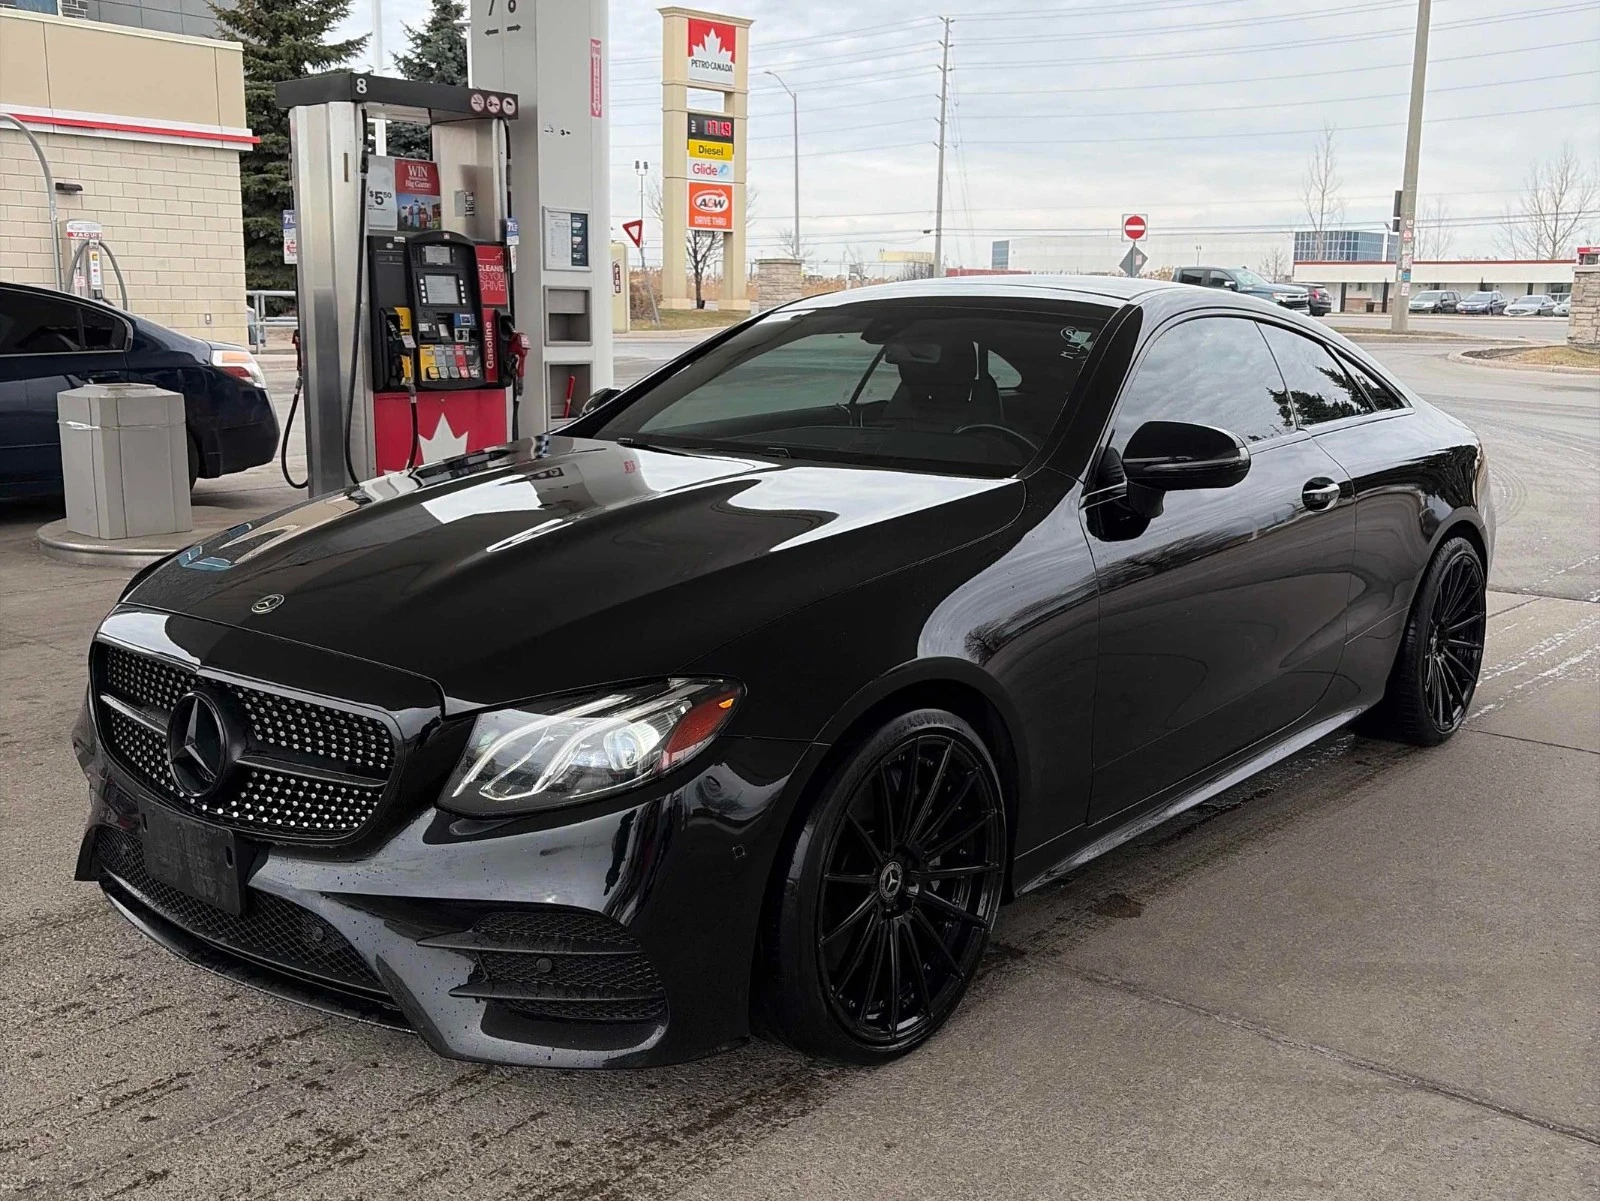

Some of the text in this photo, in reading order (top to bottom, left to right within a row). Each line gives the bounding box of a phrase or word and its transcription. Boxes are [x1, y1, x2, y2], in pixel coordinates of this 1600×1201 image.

[691, 59, 733, 72] PETRO-CANADA
[356, 77, 368, 94] 8
[698, 145, 724, 155] Diesel
[408, 165, 428, 177] WIN
[692, 163, 718, 176] Glide
[698, 198, 726, 209] A&W
[489, 272, 504, 281] YOU
[480, 280, 505, 291] DRIVE
[485, 321, 495, 369] Gasoline
